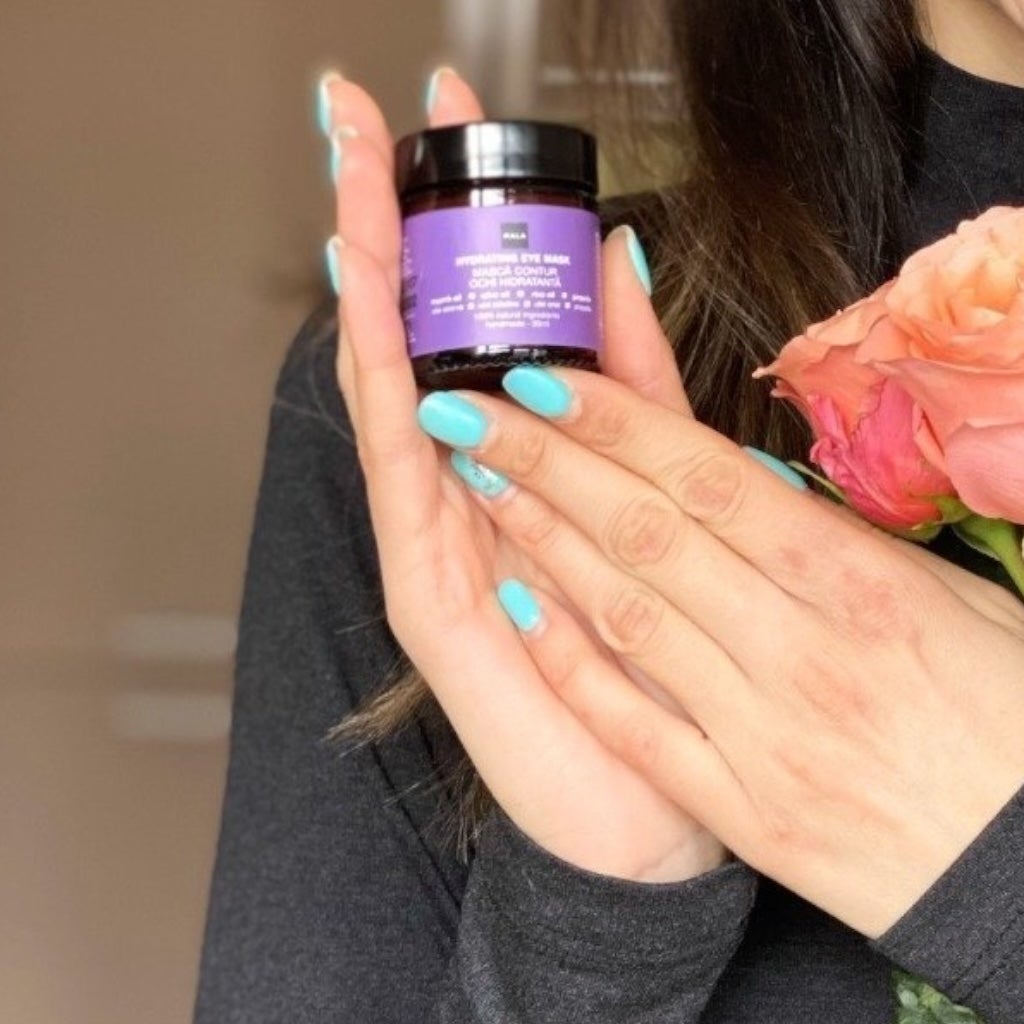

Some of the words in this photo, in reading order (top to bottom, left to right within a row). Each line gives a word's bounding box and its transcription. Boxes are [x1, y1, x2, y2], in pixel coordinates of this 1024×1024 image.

[455, 254, 518, 266] HYDRATING
[520, 253, 541, 265] EYE
[543, 254, 571, 266] MASK
[514, 266, 559, 277] CONTUR
[468, 277, 497, 289] OCHI
